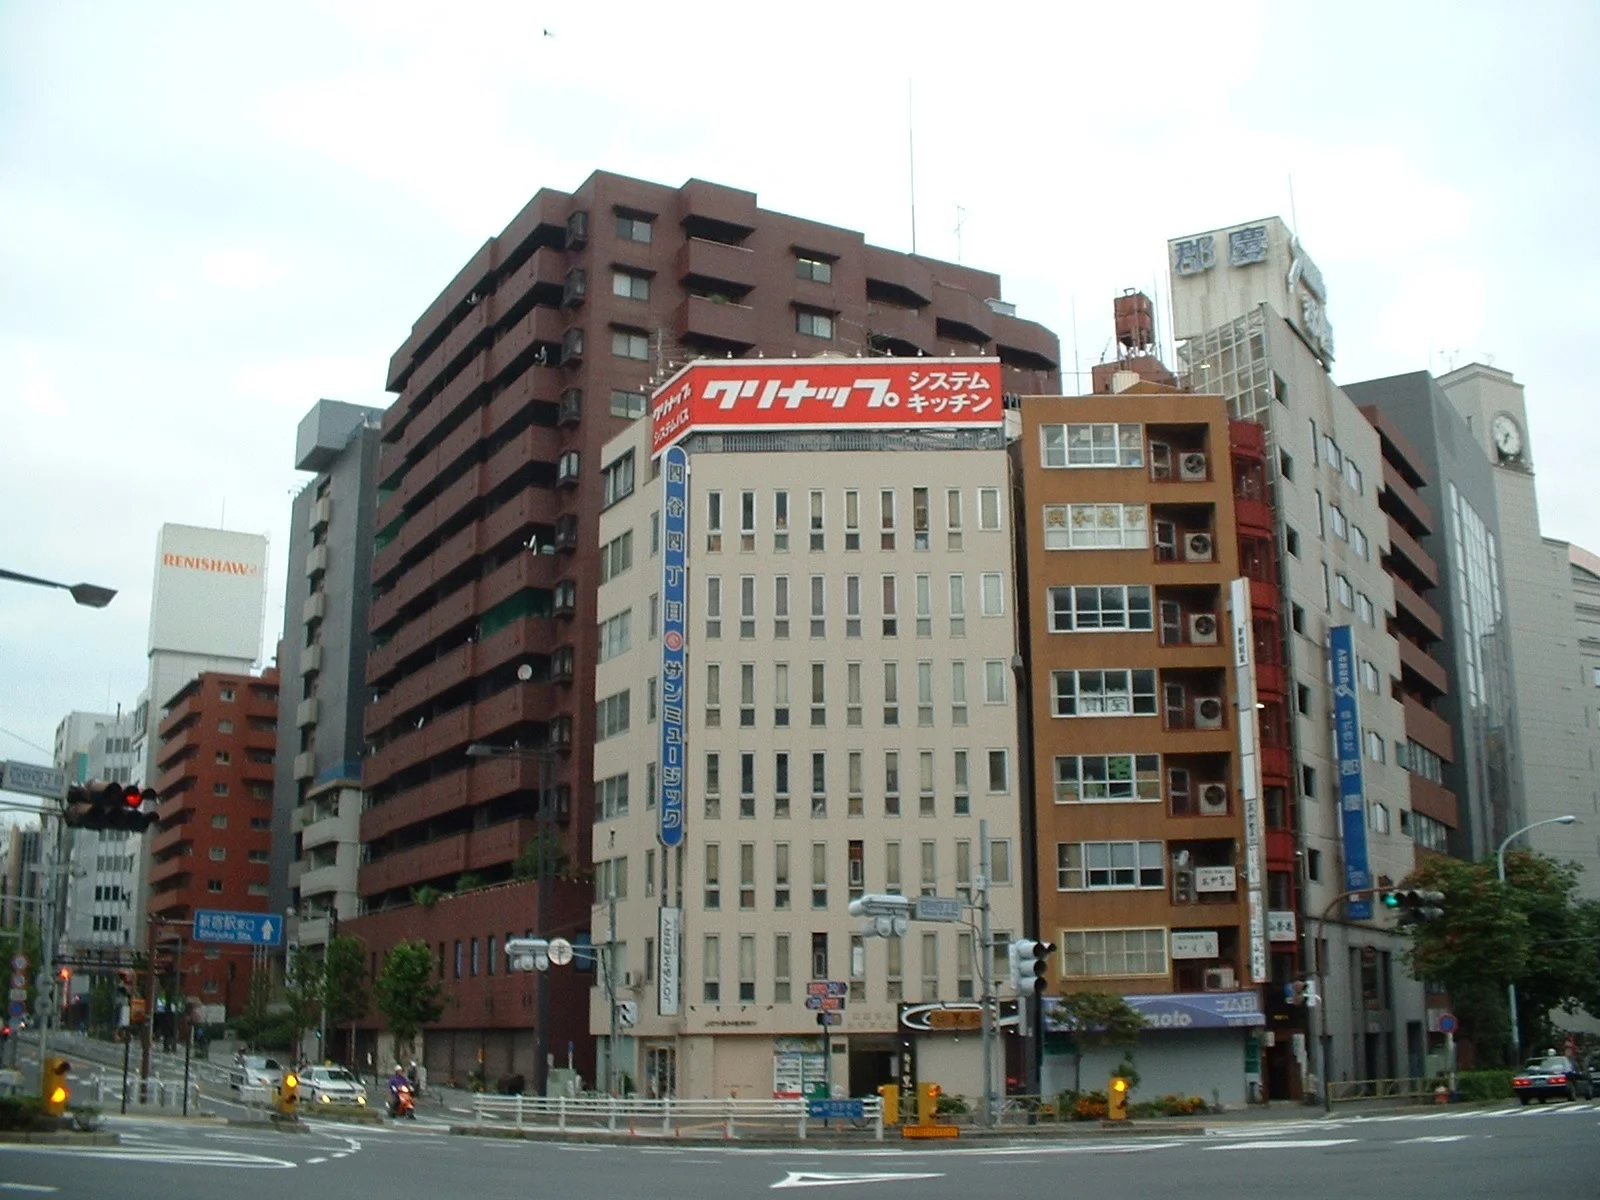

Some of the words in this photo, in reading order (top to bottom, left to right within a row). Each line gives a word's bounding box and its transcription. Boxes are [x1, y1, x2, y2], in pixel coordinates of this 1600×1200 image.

[702, 379, 900, 409] クリナップ
[907, 371, 990, 391] システム
[906, 393, 993, 414] キッチン
[665, 461, 685, 623] 四谷四丁目
[162, 553, 249, 575] RENISHAW
[662, 918, 673, 1005] JOY&MERRY
